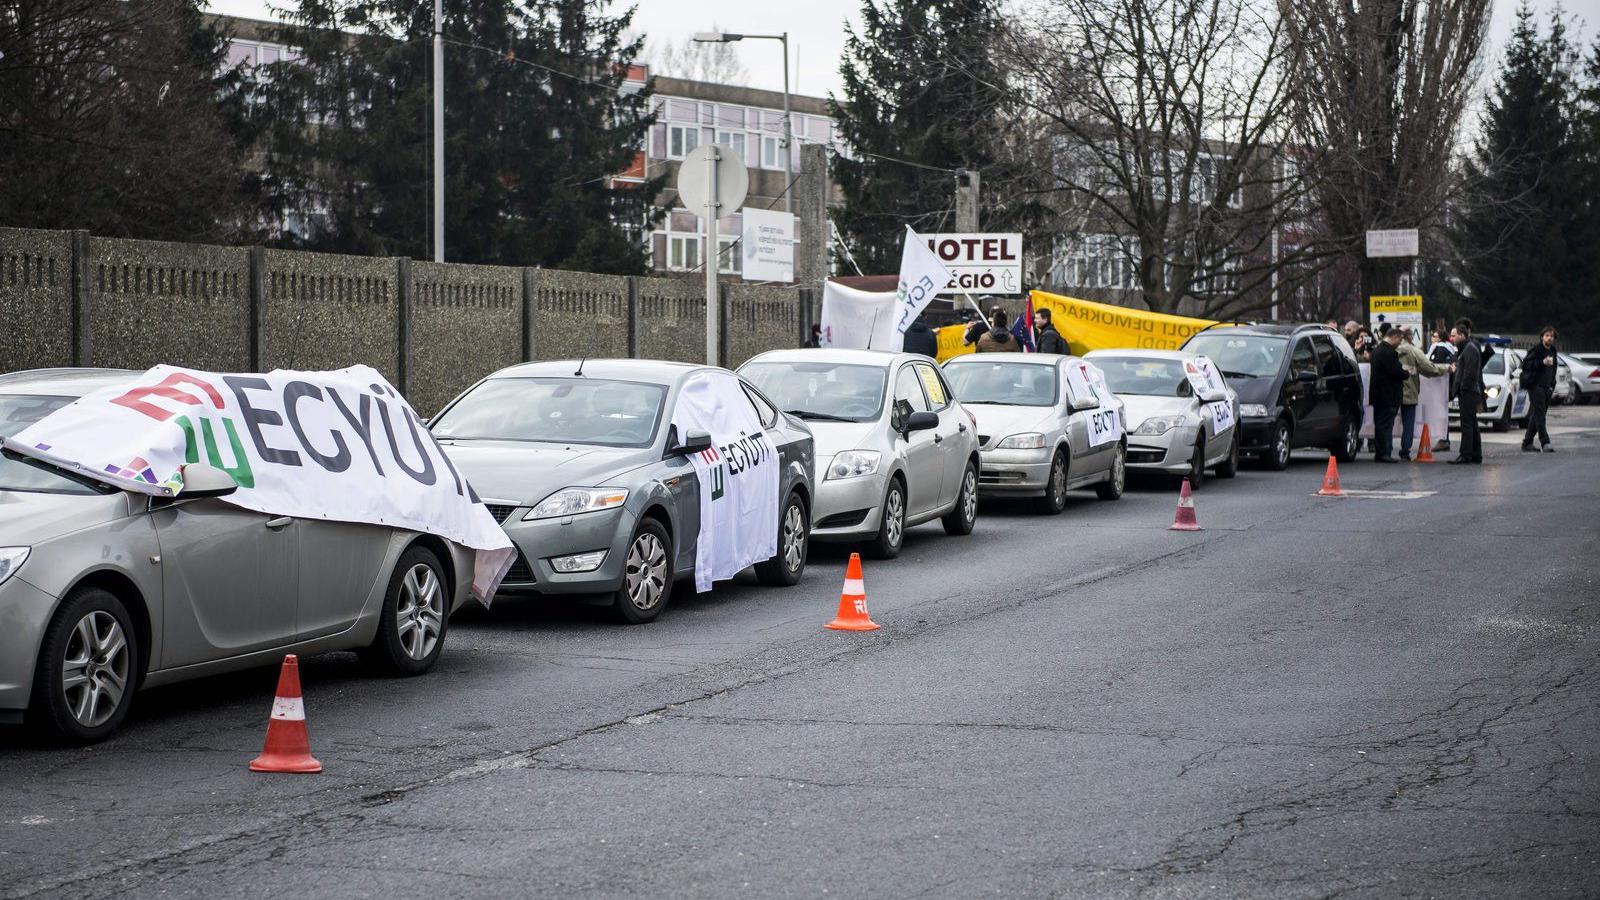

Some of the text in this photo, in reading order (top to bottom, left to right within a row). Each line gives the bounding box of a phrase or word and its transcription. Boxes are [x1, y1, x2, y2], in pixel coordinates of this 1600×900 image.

[928, 239, 1016, 261] OTEL
[943, 268, 995, 289] ÉGIÓ
[1374, 299, 1417, 309] profirent
[223, 376, 484, 505] EGYÜT
